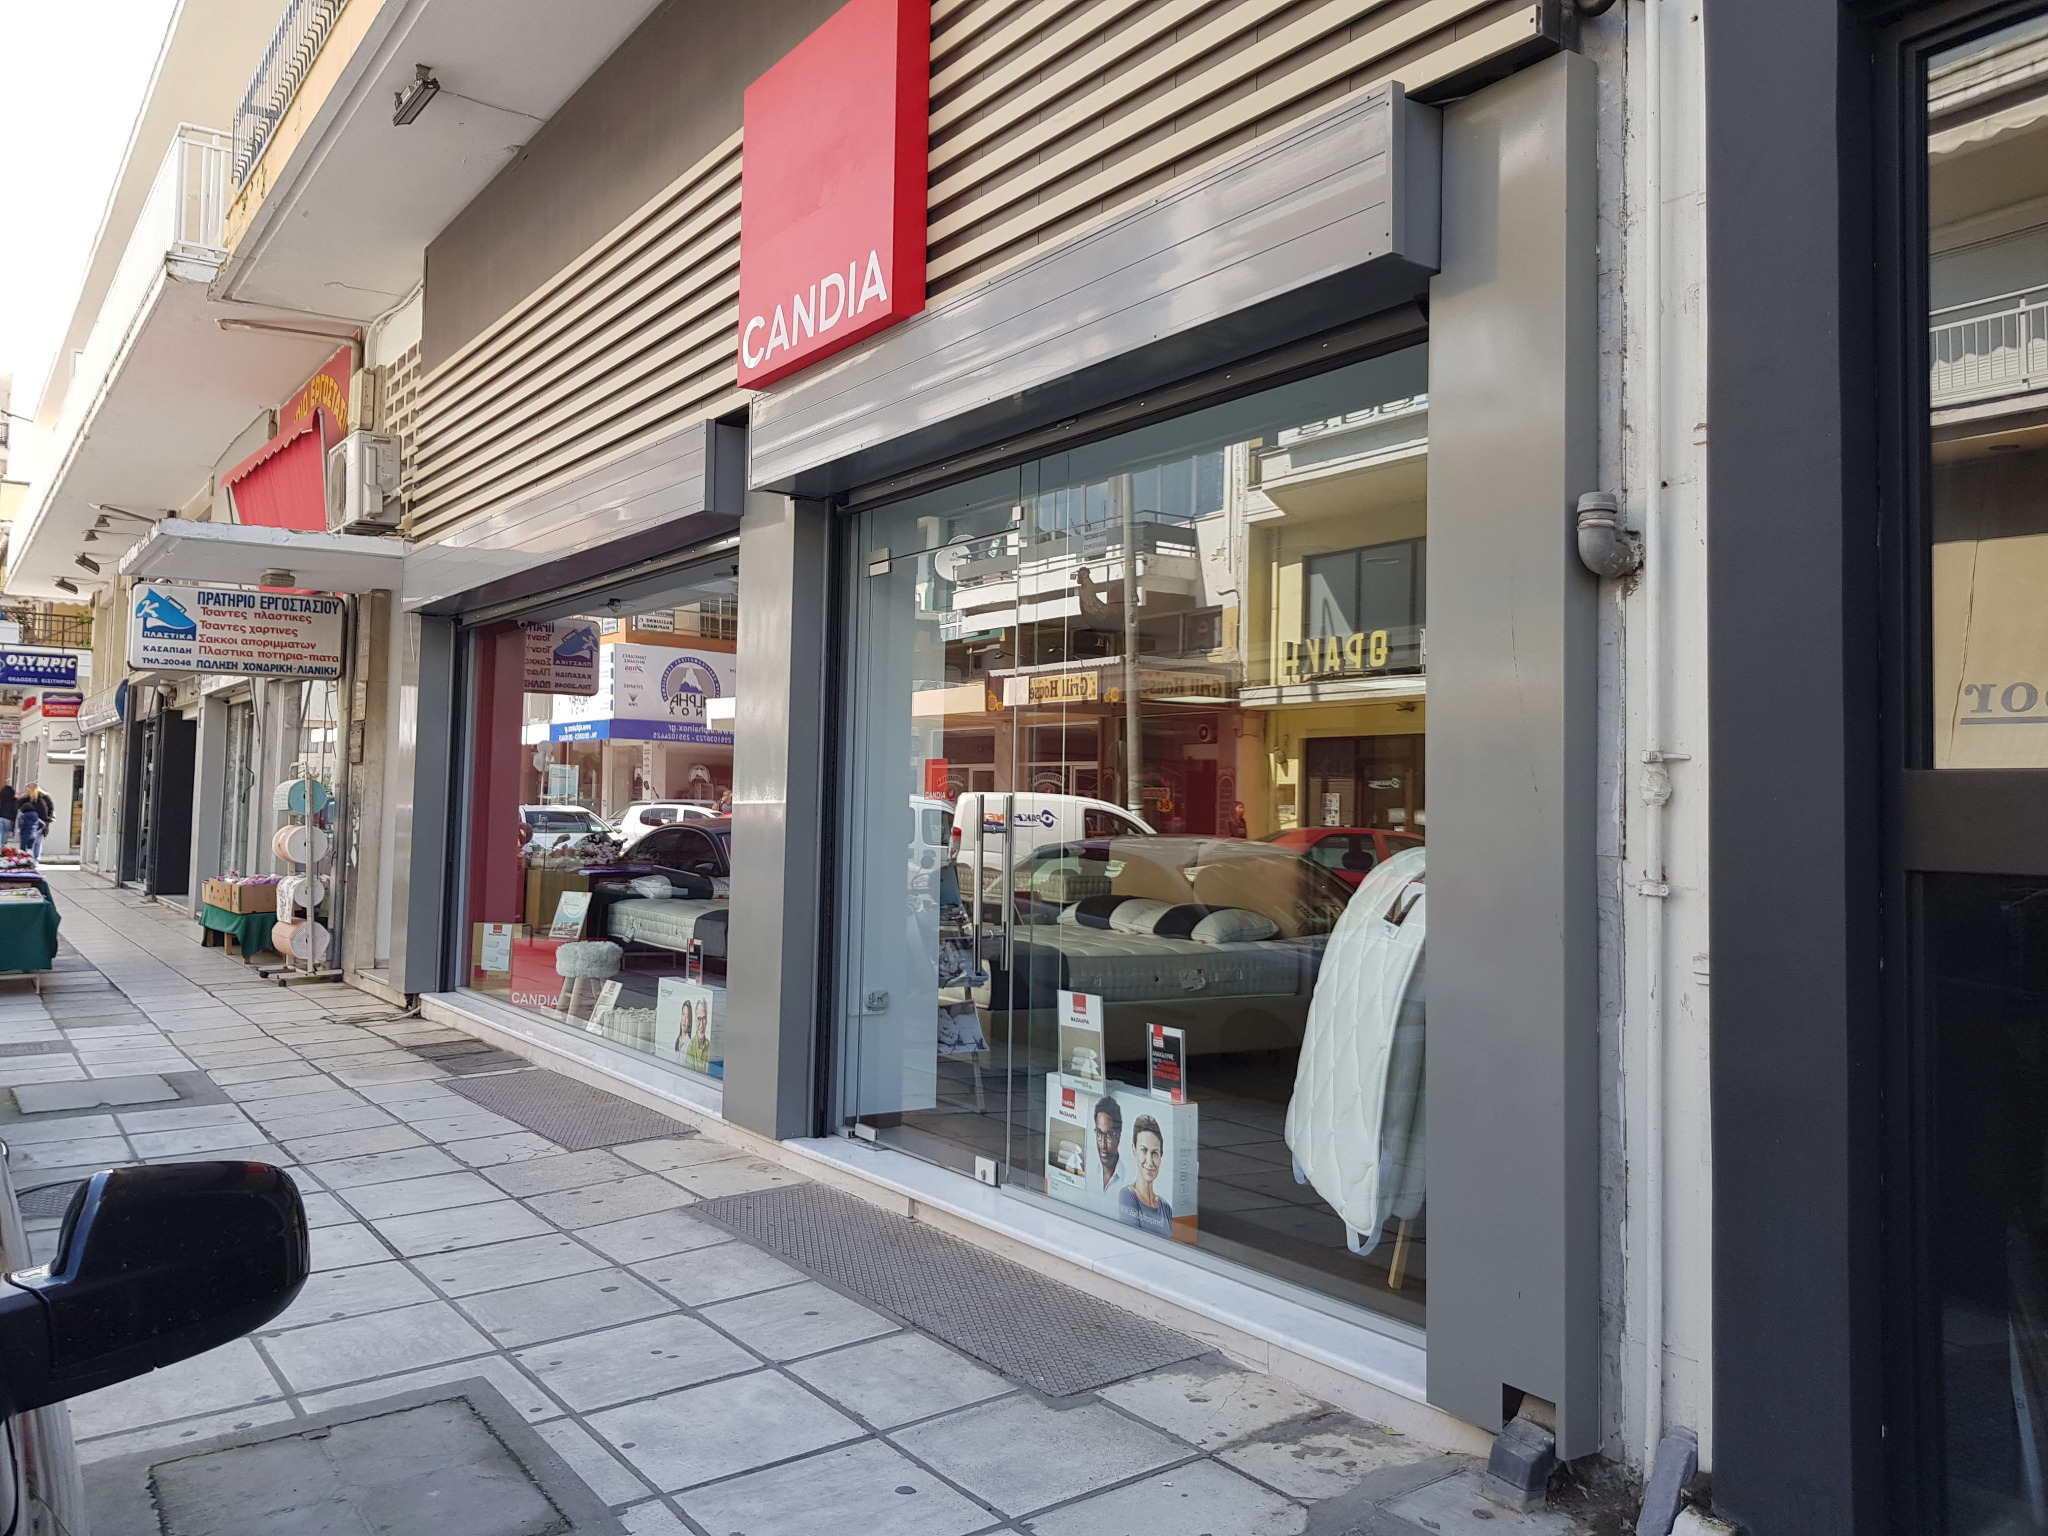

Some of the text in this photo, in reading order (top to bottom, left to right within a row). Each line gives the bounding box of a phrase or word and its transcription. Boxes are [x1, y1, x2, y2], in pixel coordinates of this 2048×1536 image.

[742, 249, 888, 369] CANDIA
[197, 591, 340, 615] ΠΡΑΤΗΡΙΟ ΕΡΓΟΣΤΑΣΙΟΥ
[200, 606, 313, 625] Τσαντες πλαστικες
[143, 631, 194, 641] ΠΛΑΣΤΙΚΑ
[199, 619, 299, 637] Τσαντες χαρτινες
[142, 644, 193, 655] ΚΑΣΑΠΙΔΗ
[198, 633, 317, 650] Σακκοι αποριμματων
[198, 645, 256, 658] Πλαστικα
[6, 654, 77, 669] OLYMPIC
[196, 659, 238, 671] ΠΩΛΗΣΗ
[511, 991, 559, 1007] CANDIA
